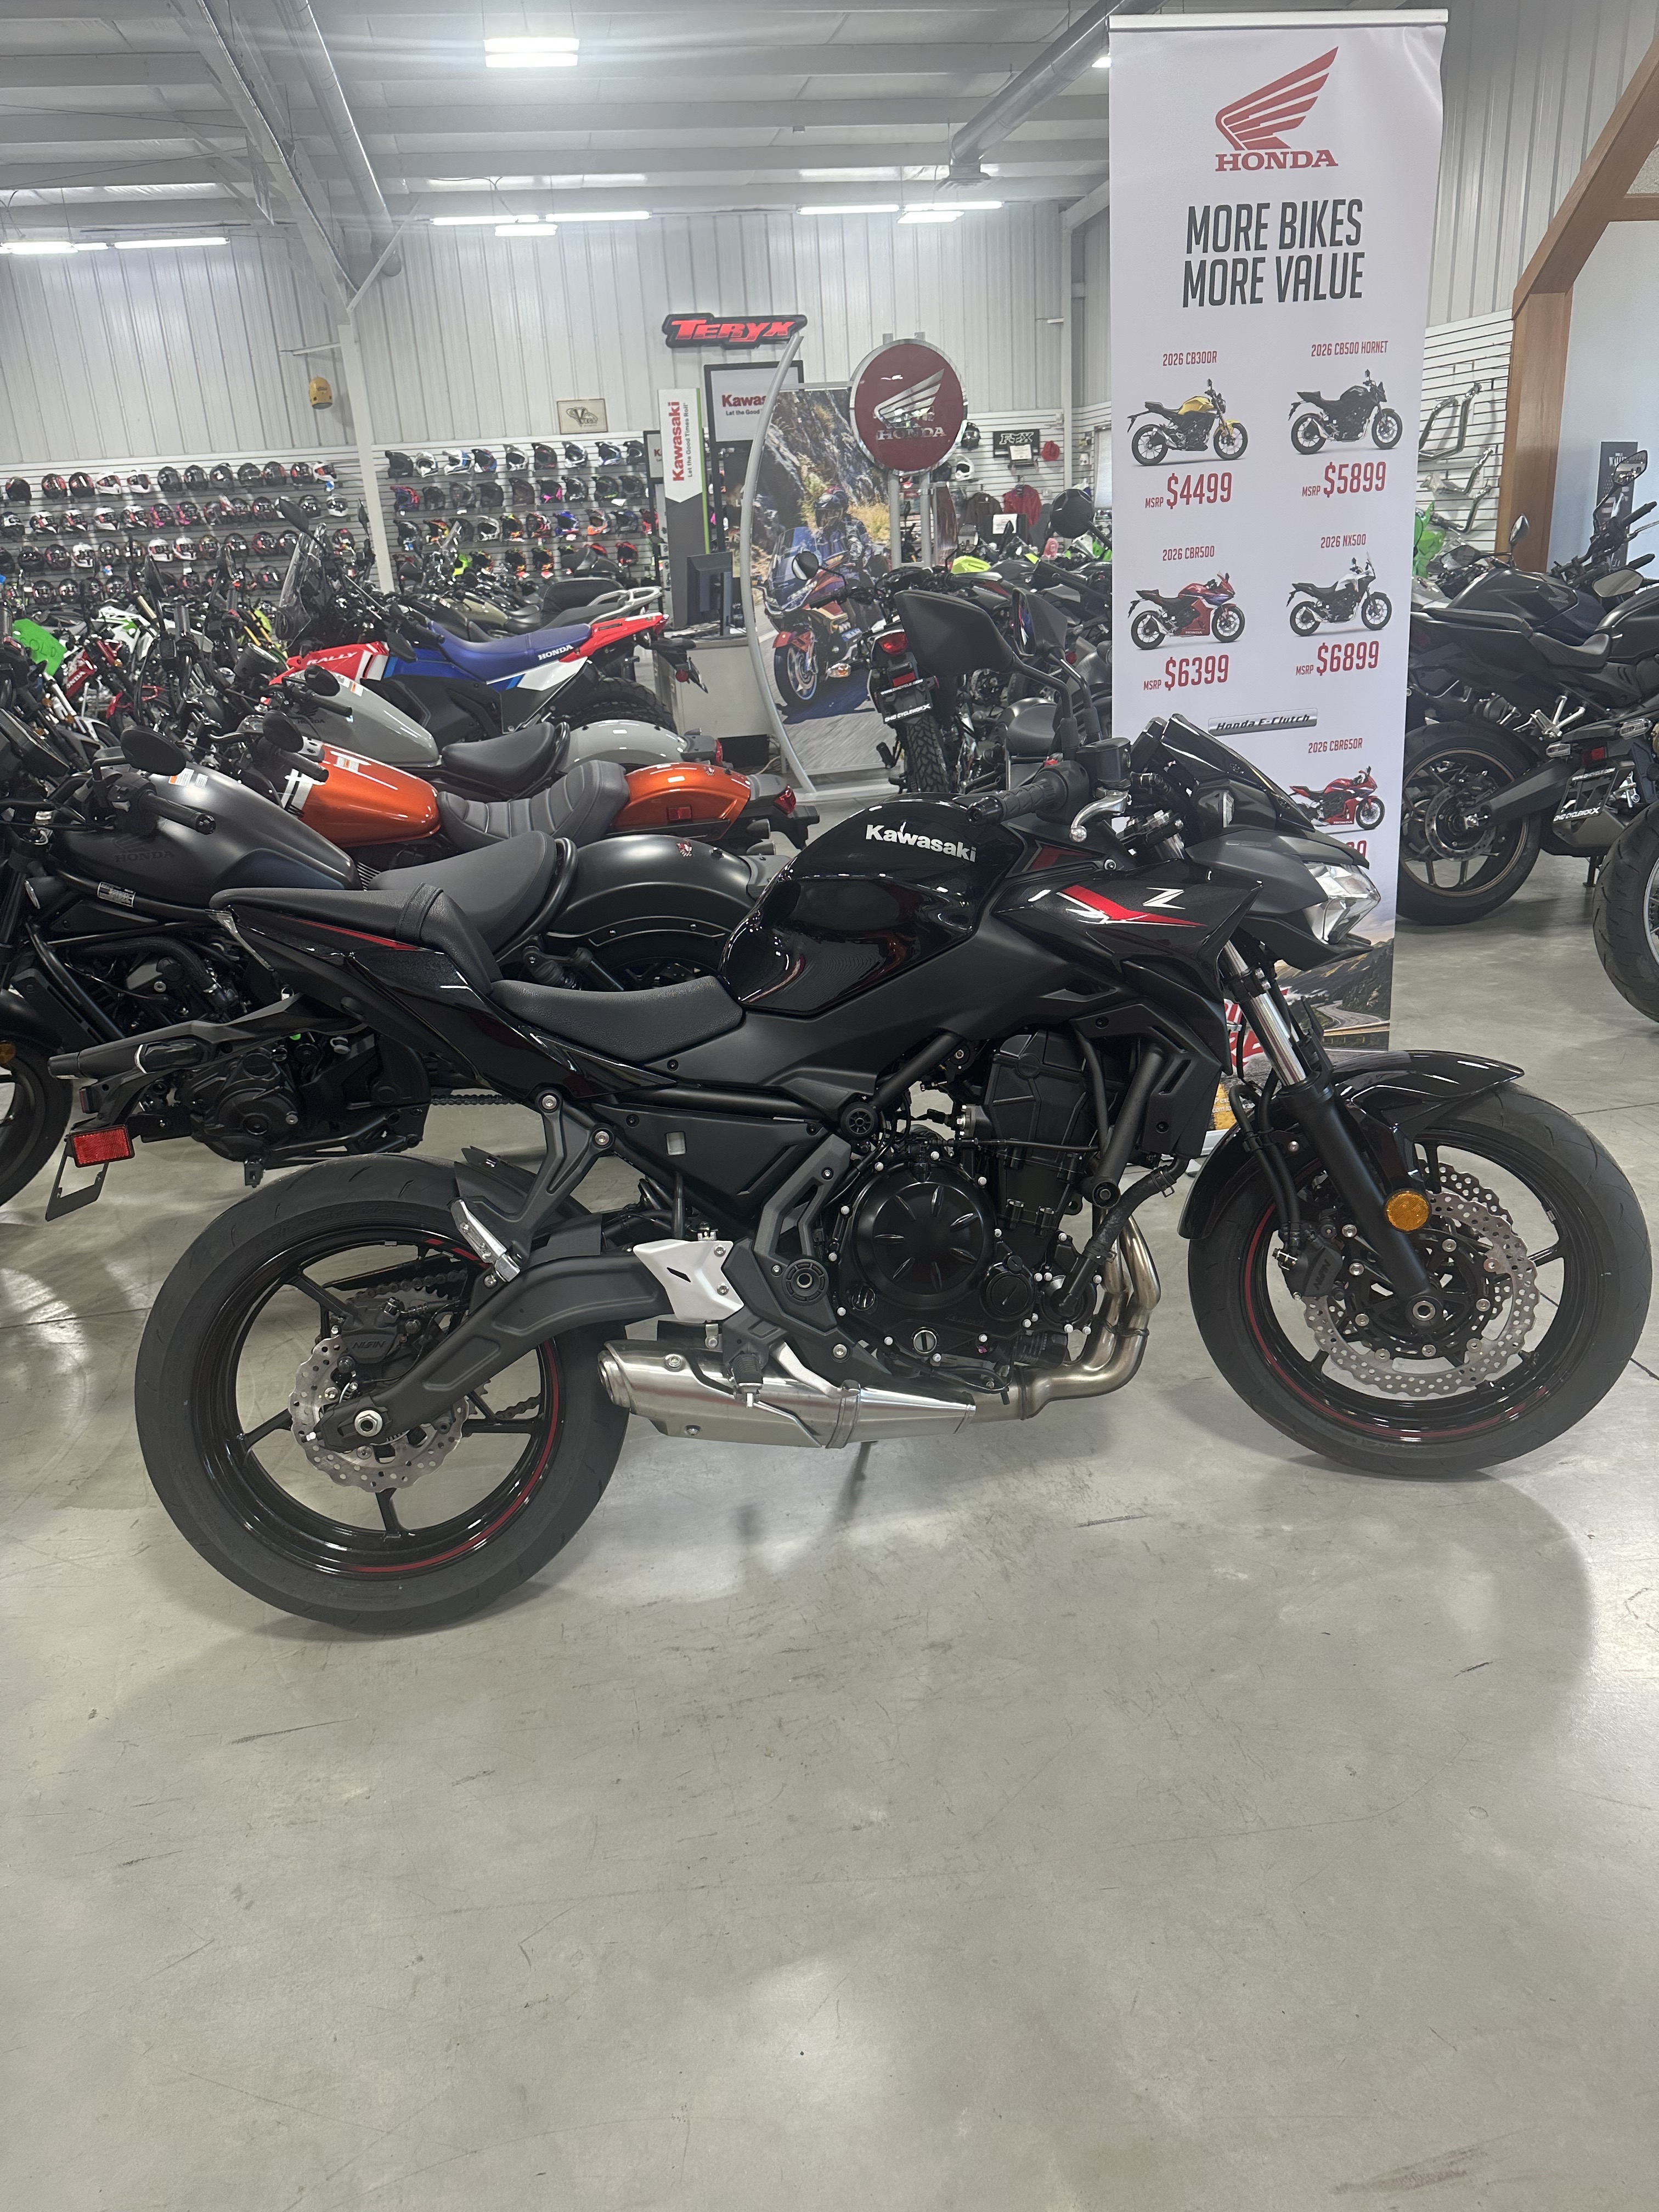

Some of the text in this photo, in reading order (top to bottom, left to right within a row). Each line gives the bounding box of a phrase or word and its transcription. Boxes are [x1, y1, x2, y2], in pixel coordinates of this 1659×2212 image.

[1215, 149, 1339, 172] HONDA
[1186, 199, 1364, 254] MORE BIKES
[1183, 252, 1365, 308] MORE VALUE
[1311, 340, 1389, 357] 2026 CB500 HORNET
[1163, 351, 1217, 366] 2026 CB300R
[668, 402, 685, 481] Kawasaki
[876, 427, 947, 441] HONDA
[1302, 461, 1386, 498] MSRP $5899
[1145, 472, 1232, 509] MSRP $4499
[1321, 534, 1366, 549] 2026 NX500
[1163, 545, 1215, 561] 2026 CBR500
[306, 651, 358, 665] RALLY
[537, 644, 574, 661] HONDA
[1296, 640, 1379, 676] MSRP $6899
[1143, 654, 1229, 691] MSRP $6399
[1216, 714, 1310, 731] Honda E-Clutch
[1308, 738, 1363, 754] 2026 CBR650R
[866, 825, 977, 862] Kawasaki
[114, 851, 175, 863] HONDA
[1143, 887, 1186, 910] Z
[352, 1340, 386, 1349] NISSIN
